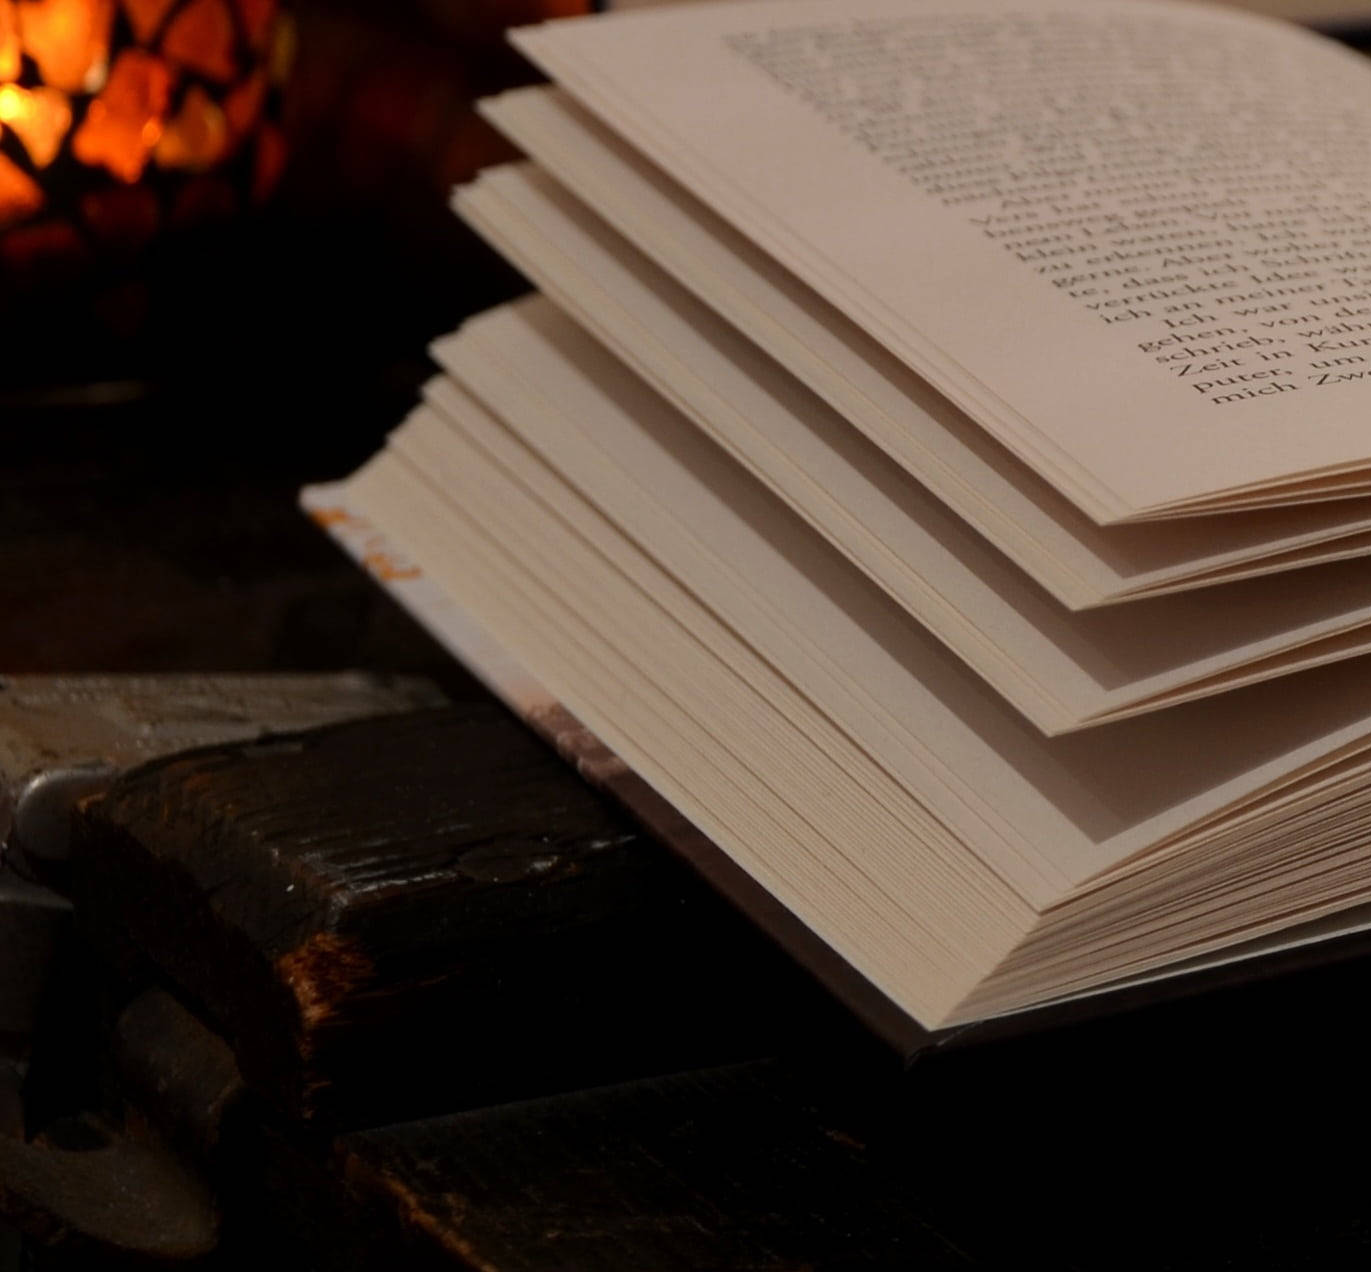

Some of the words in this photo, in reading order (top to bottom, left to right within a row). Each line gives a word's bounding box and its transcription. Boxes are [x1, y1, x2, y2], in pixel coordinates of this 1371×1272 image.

[1162, 252, 1233, 269] Aber
[1085, 281, 1235, 311] verrückte
[1249, 271, 1317, 285] Idee
[1122, 274, 1189, 290] dass
[1100, 309, 1152, 325] ich
[1167, 302, 1202, 313] an
[1215, 284, 1325, 305] meiner
[1163, 313, 1217, 329] Ich
[1233, 303, 1289, 317] war
[1137, 327, 1248, 353] gehen,
[1260, 315, 1321, 328] von
[1155, 336, 1286, 364] schrieb,
[1169, 358, 1241, 377] Zeit
[1256, 350, 1293, 362] in
[1192, 368, 1293, 394] puter,
[1310, 356, 1366, 369] um
[1211, 381, 1298, 405] mich
